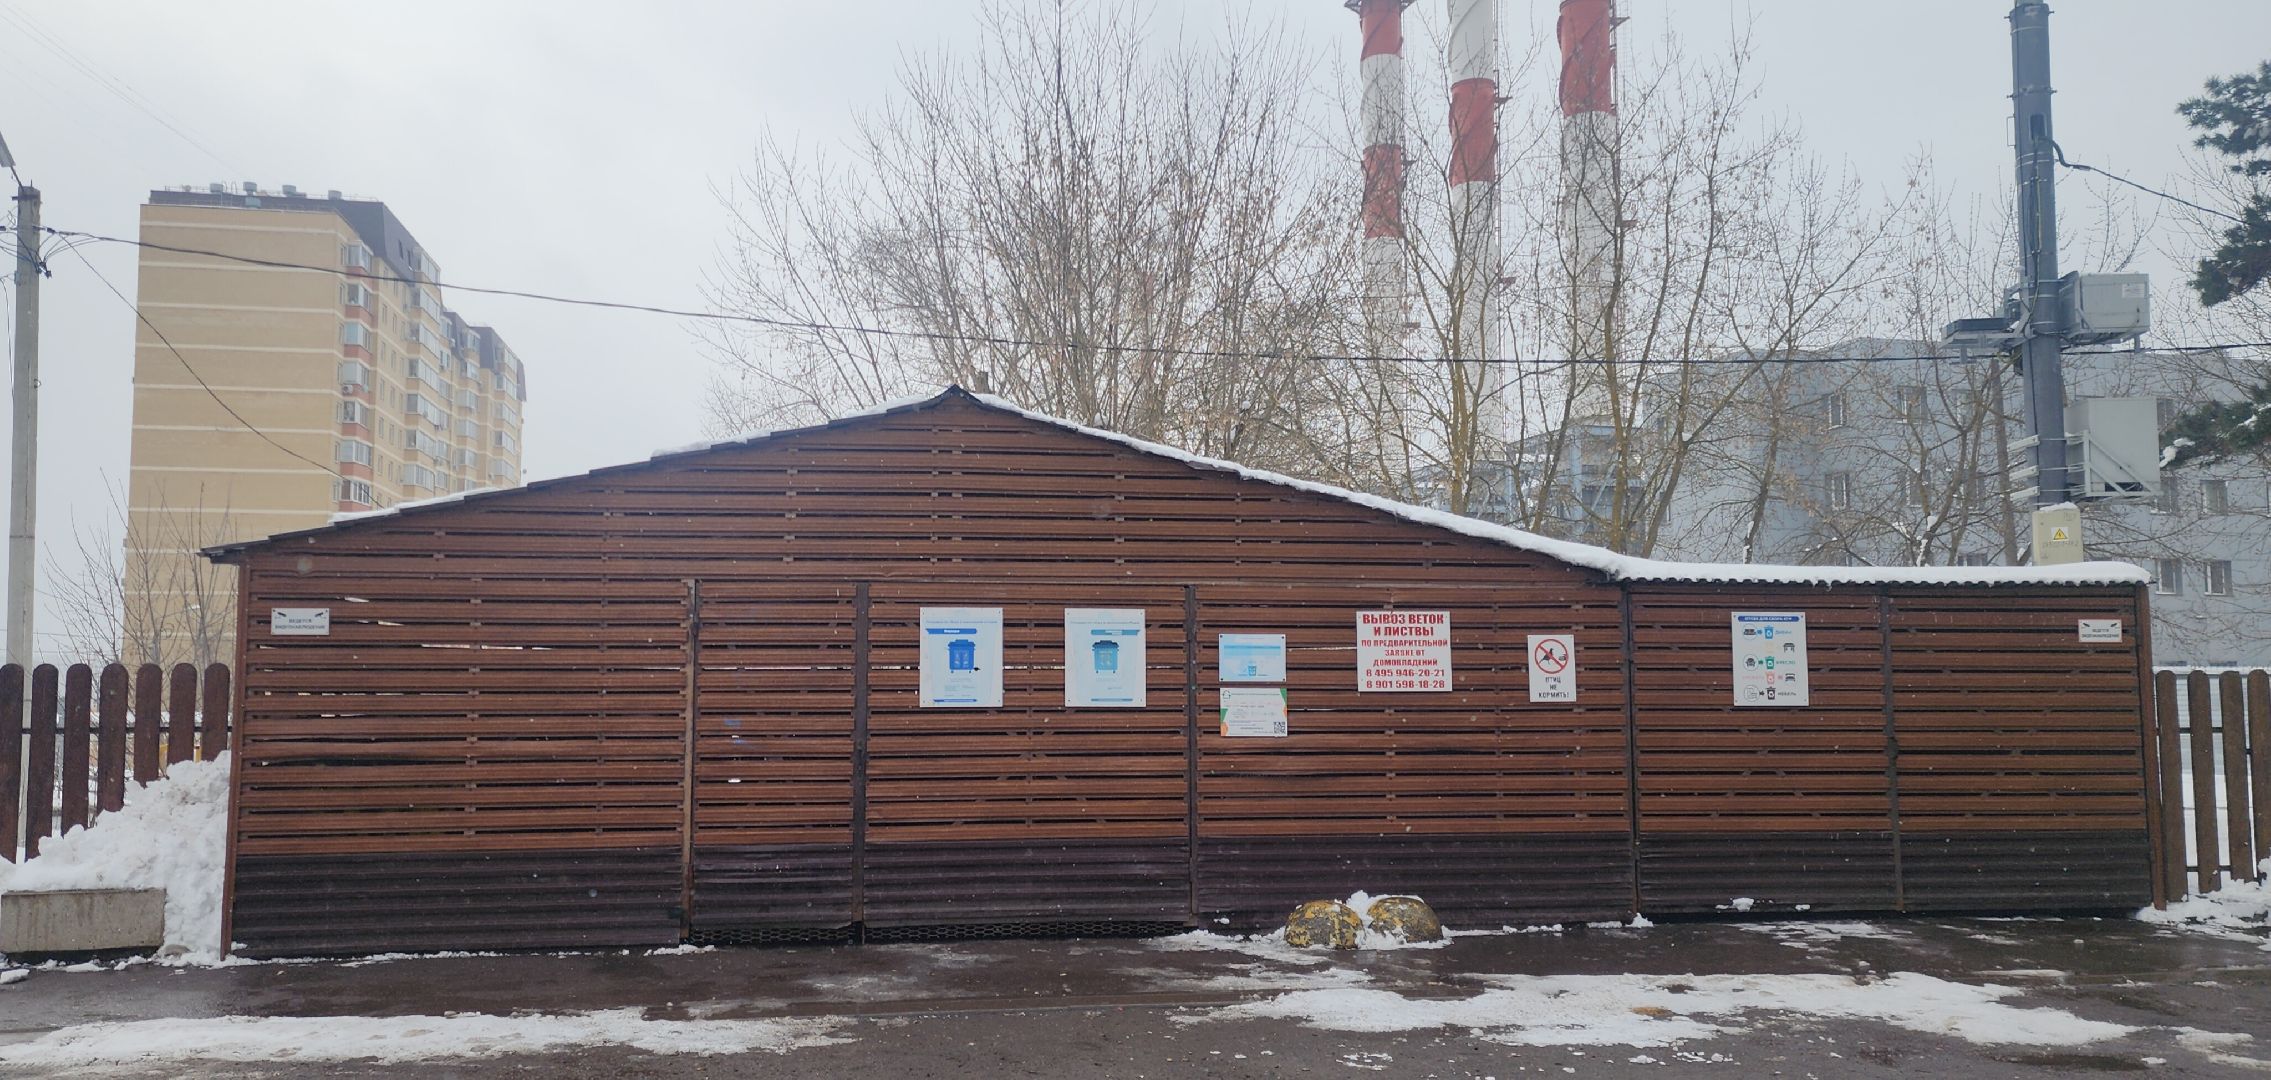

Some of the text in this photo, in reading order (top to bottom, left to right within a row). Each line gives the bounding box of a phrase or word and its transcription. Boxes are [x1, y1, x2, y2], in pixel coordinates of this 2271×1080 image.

[1362, 613, 1444, 624] ВЫВОЗ ВЕТОК
[1374, 626, 1434, 636] И ЛИСТВЫ
[1361, 638, 1448, 648] ПО ПРЕДВАРИТЕЛЬНОЙ
[1373, 658, 1438, 667] ДОМОВЛАДЕНИЙ
[1366, 669, 1445, 677] 8 495 946-20-21
[1366, 680, 1445, 689] 8 901 598-18-28
